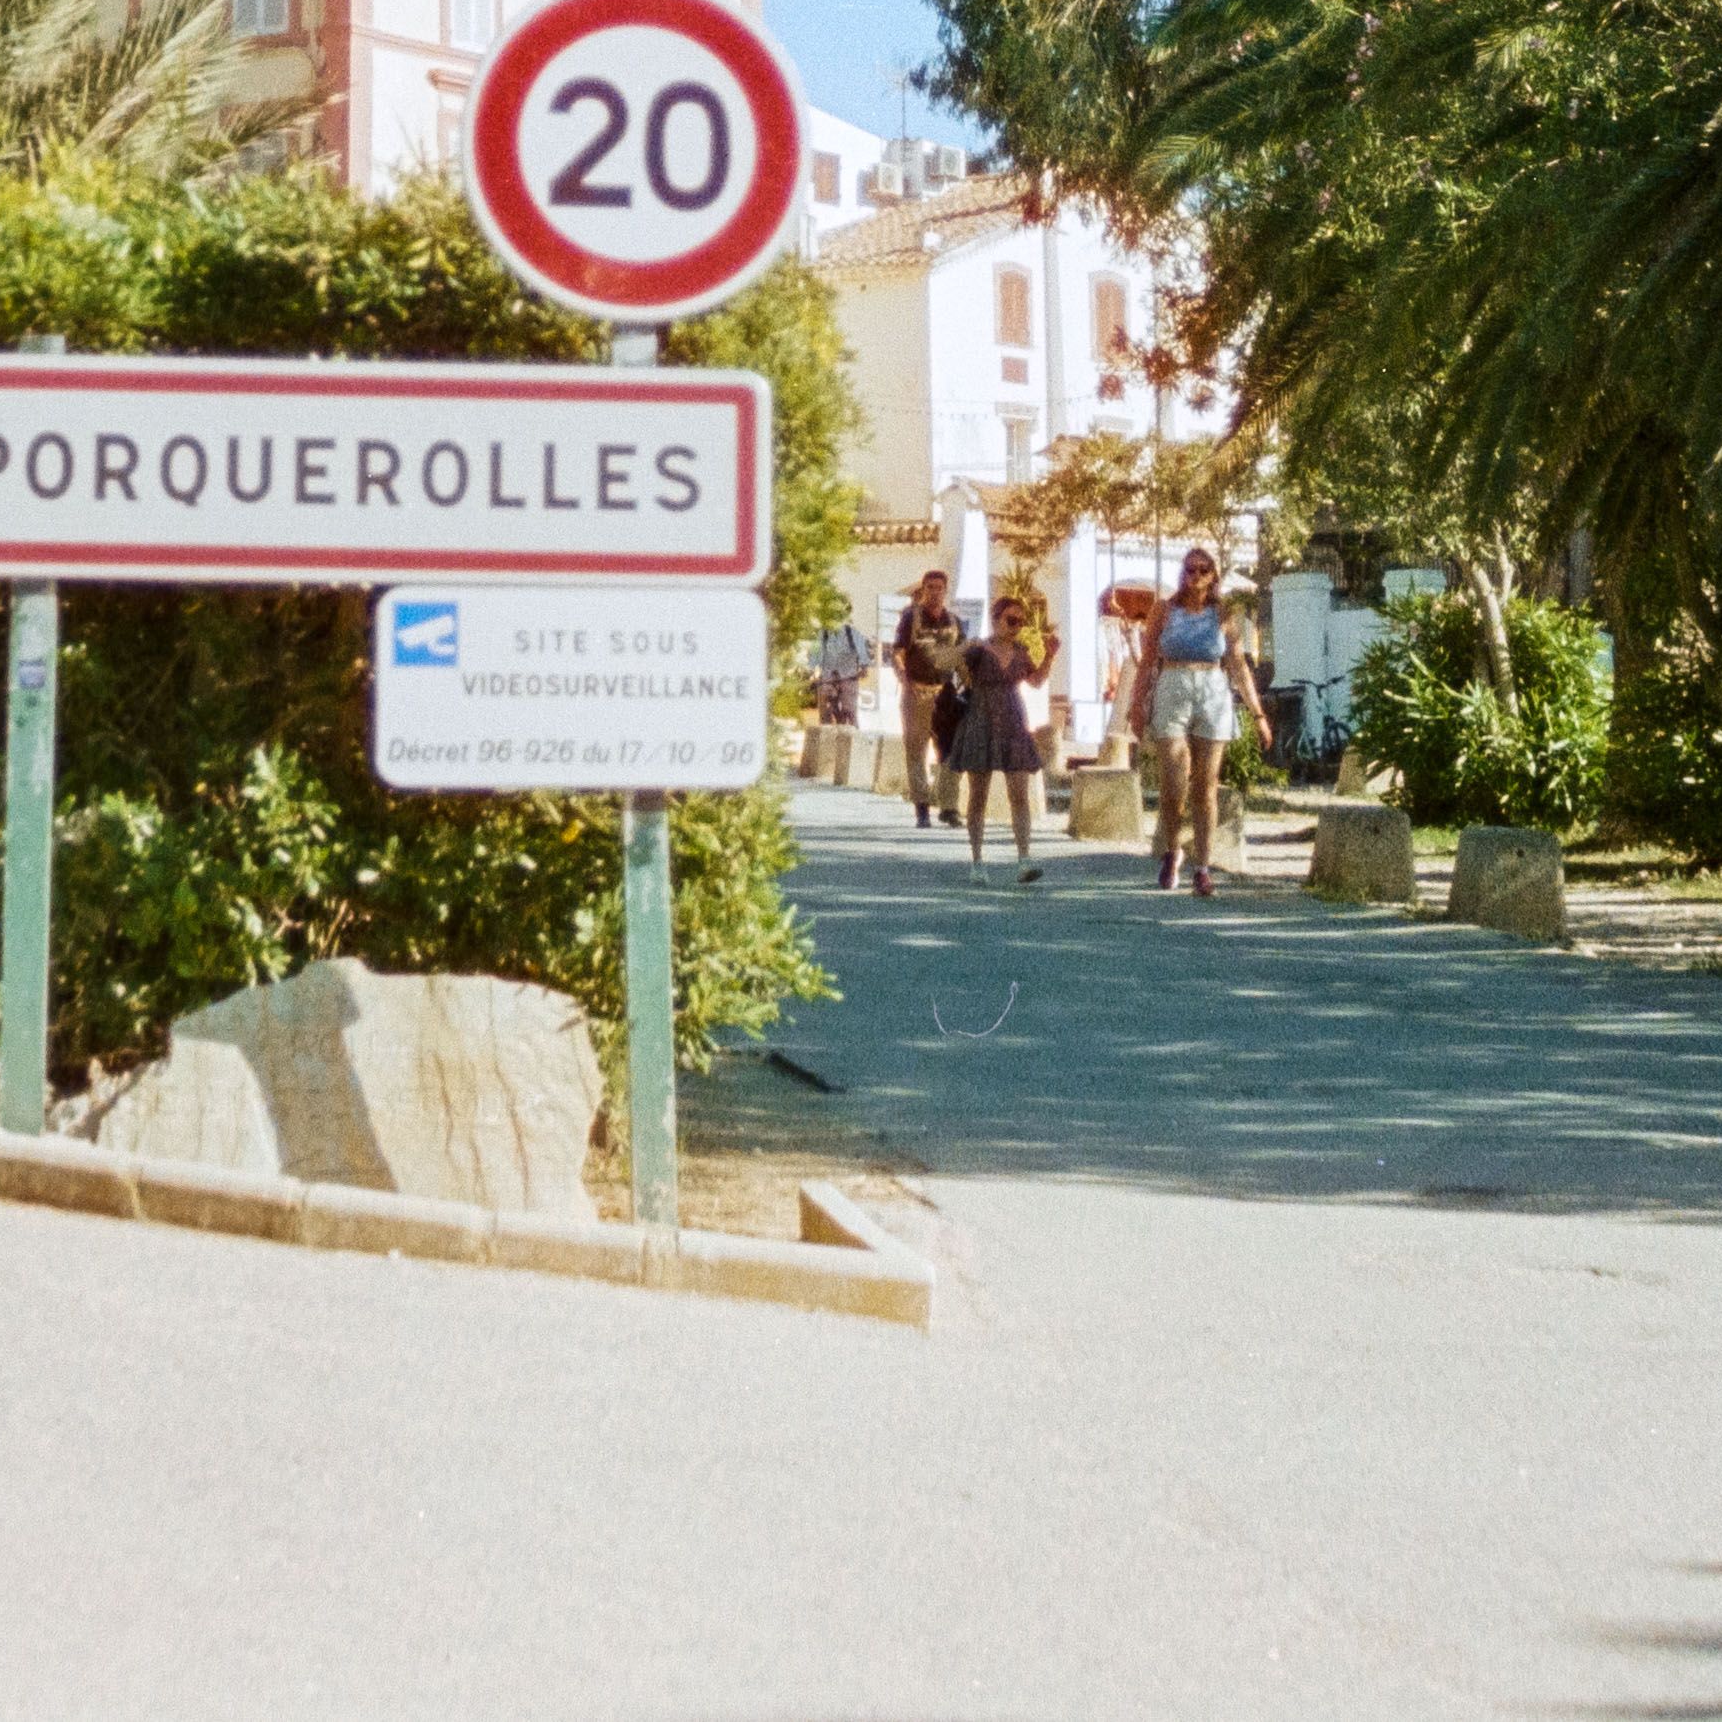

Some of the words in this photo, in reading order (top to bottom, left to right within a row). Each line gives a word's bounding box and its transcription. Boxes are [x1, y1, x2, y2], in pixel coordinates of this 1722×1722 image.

[548, 76, 731, 212] 20
[513, 628, 588, 655] SITE
[608, 630, 700, 656] SOUS
[461, 672, 750, 700] VIDEOSURVEILLANCE
[387, 738, 470, 763] Décret
[581, 741, 610, 764] du
